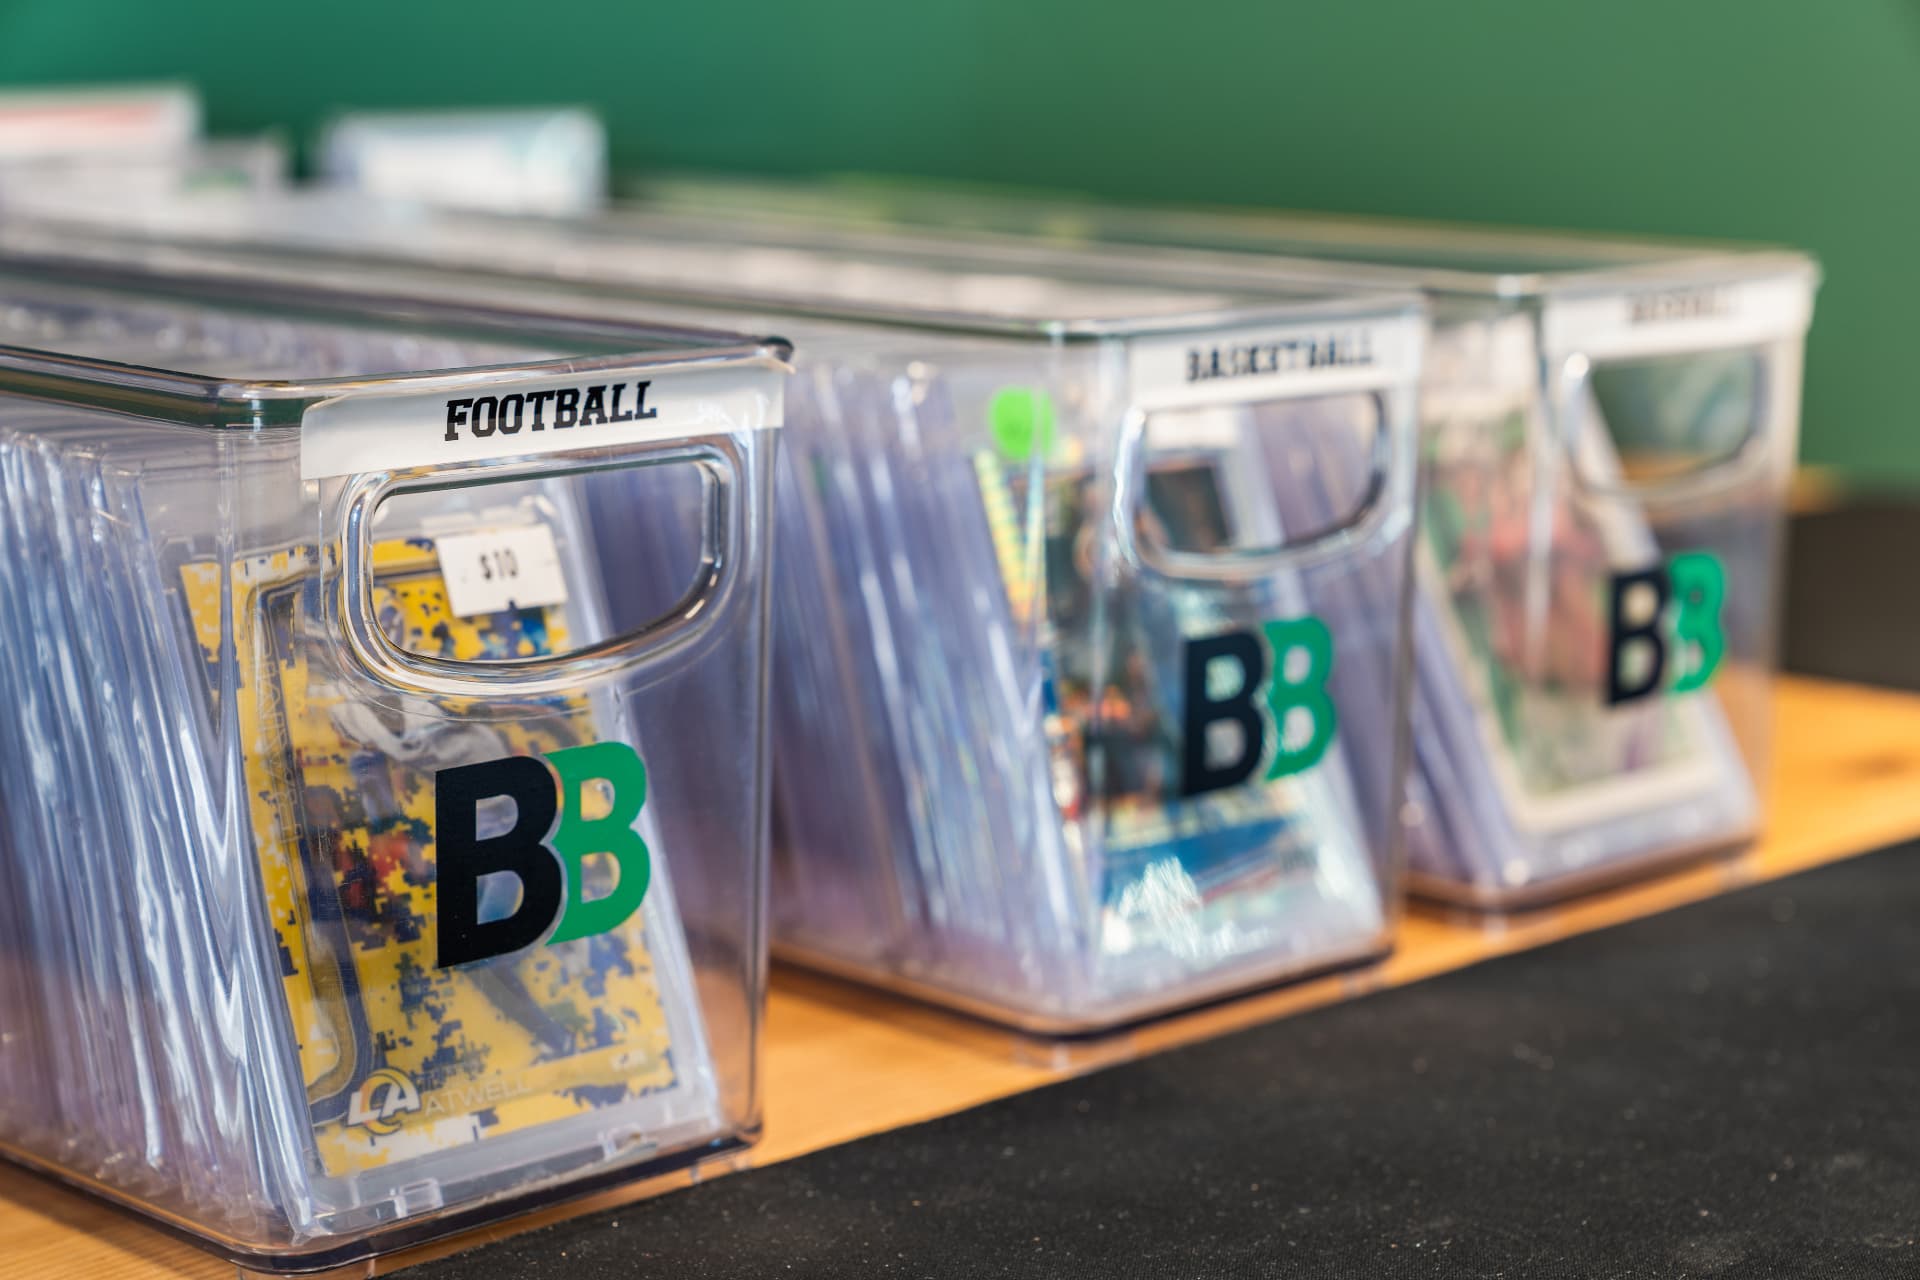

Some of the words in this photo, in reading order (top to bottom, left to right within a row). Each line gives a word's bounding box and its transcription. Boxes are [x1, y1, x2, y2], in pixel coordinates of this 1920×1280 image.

[444, 380, 657, 441] FOOTBALL
[1606, 552, 1725, 706] BB
[1184, 616, 1337, 797] BB
[435, 741, 651, 968] BB
[346, 1068, 421, 1128] LA
[424, 1074, 533, 1116] ATWELL
